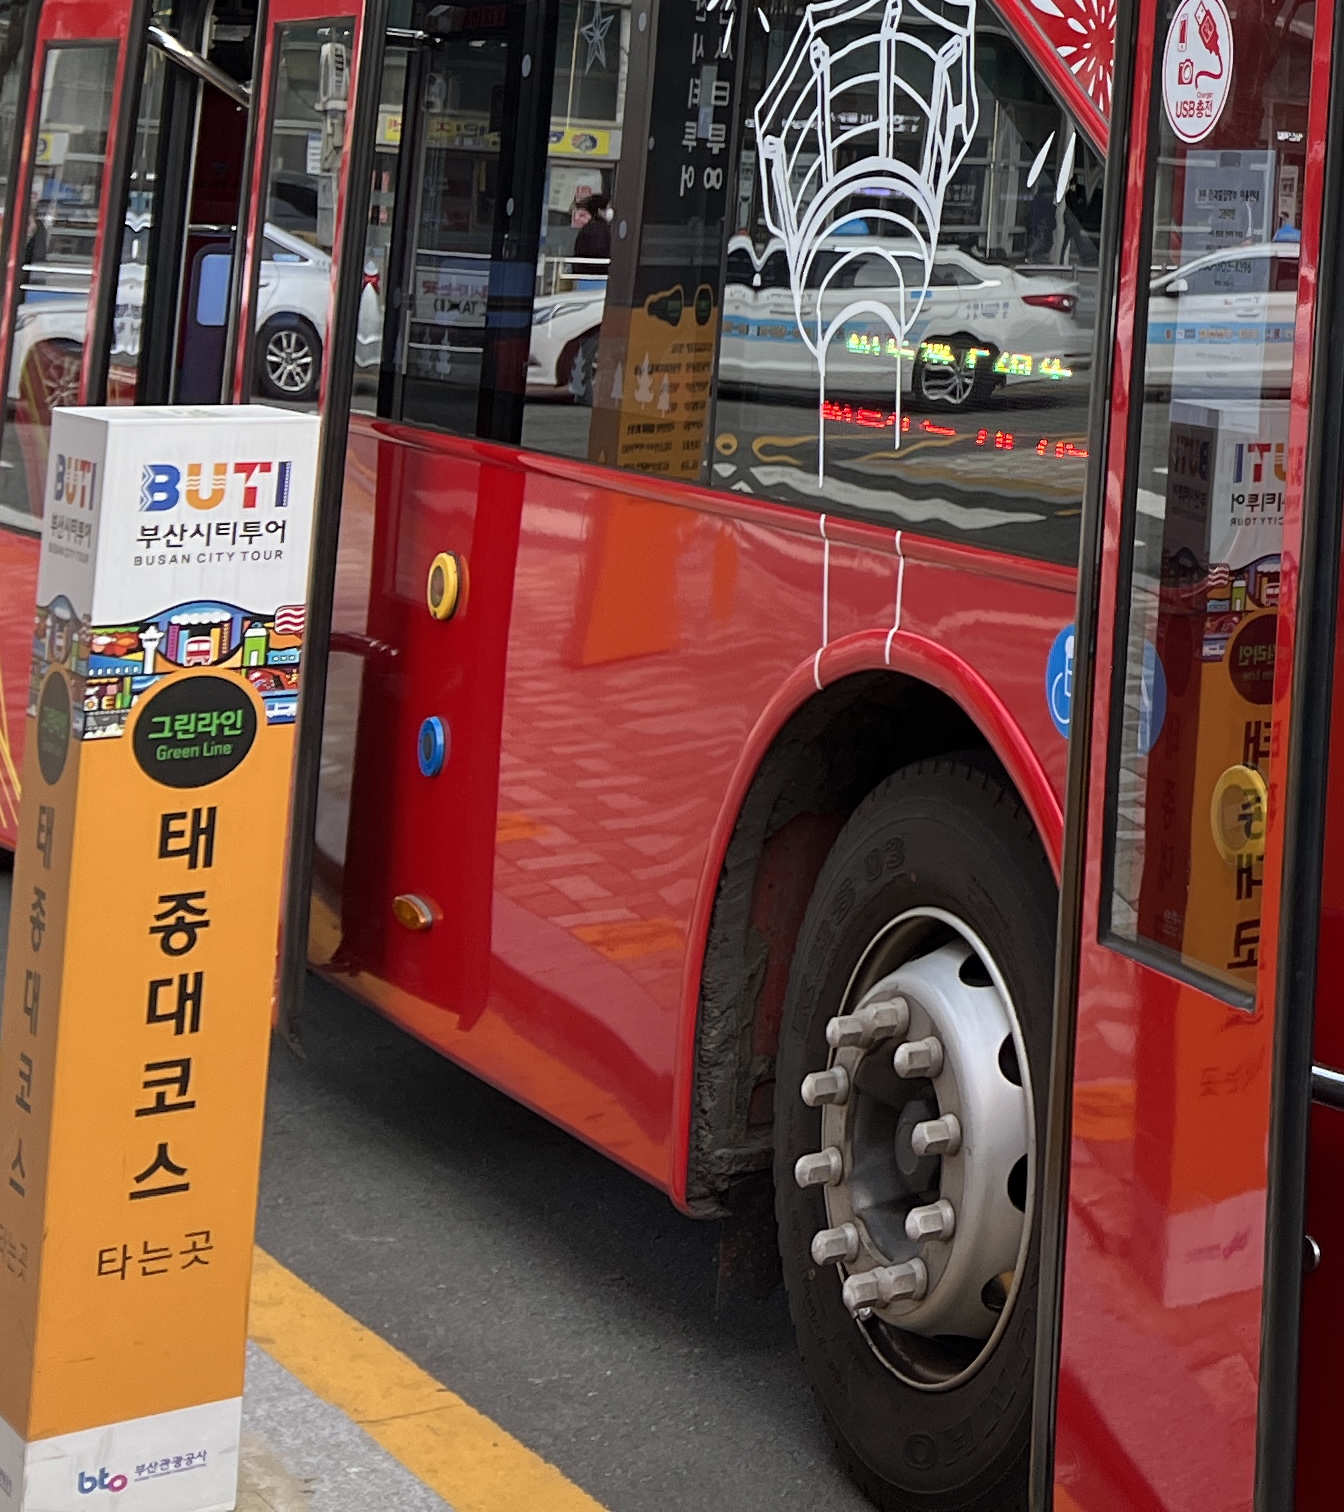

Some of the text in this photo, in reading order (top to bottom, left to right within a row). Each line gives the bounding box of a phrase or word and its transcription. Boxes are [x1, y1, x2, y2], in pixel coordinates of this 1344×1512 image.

[54, 454, 97, 511] BUTI
[138, 460, 292, 512] BUTI
[136, 519, 287, 550] 부산시티투어
[133, 549, 284, 567] BUSAN CITY TOUR
[149, 708, 243, 740] 그린라인
[156, 740, 232, 762] Green Line
[97, 1229, 214, 1281] 타는곳
[77, 1448, 208, 1495] bto 부산관광공사
